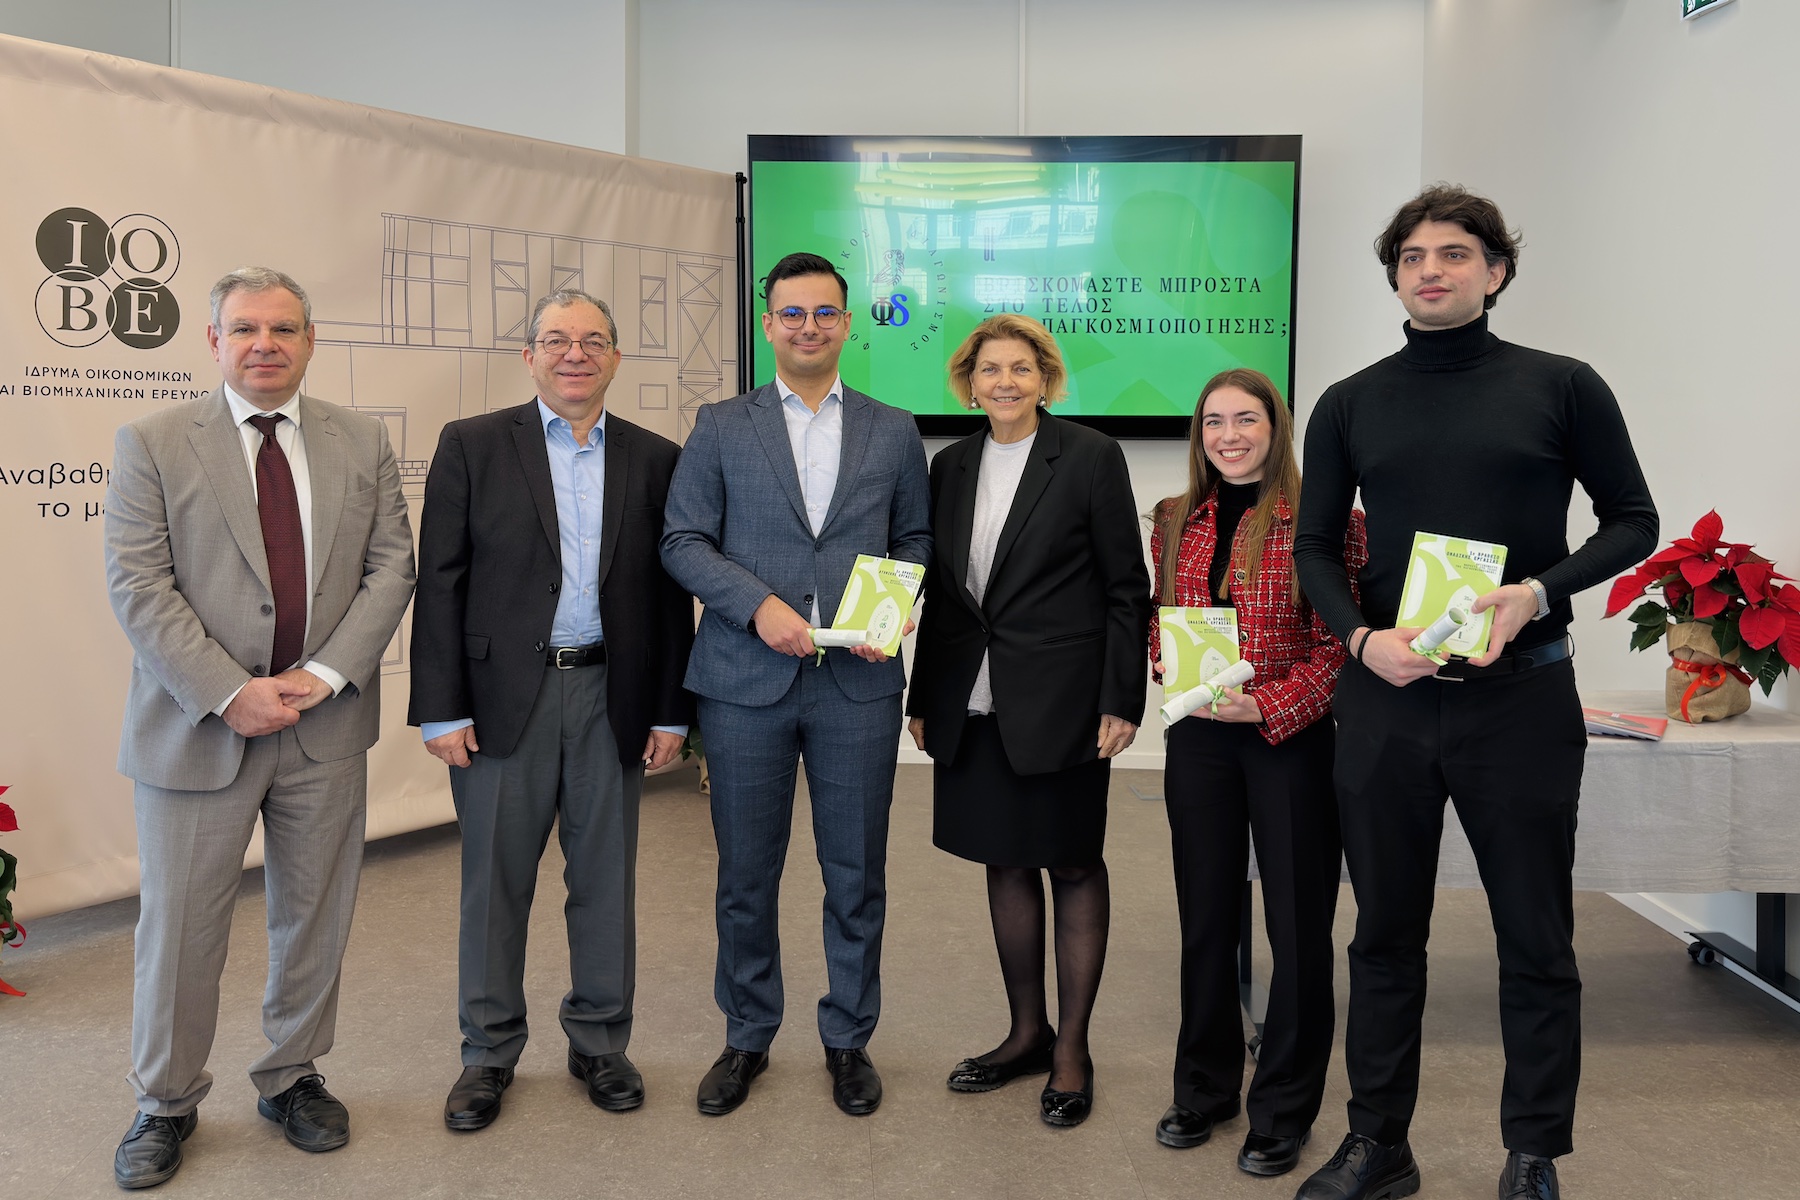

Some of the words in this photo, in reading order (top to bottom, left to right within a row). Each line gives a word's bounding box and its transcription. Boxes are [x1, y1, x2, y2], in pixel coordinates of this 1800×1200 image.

[1160, 276, 1262, 293] ΜΠΡΟΣΤΑ
[984, 298, 1025, 313] ΣΤΟ
[1042, 297, 1112, 313] ΤΕΛΟΣ
[1042, 317, 1288, 338] ΠΑΓΚΟΣΜΙΟΠΟΙΗΣΗΣ;
[25, 366, 80, 379] ΙΔΡΥΜΑ
[86, 369, 192, 382] ΟΙΚΟΝΟΜΙΚΩΝ
[23, 385, 145, 399] ΒΙΟΜΗΧΑΝΙΚΩΝ
[0, 462, 110, 489] ναβαθ
[37, 502, 70, 518] το
[85, 502, 105, 521] μ
